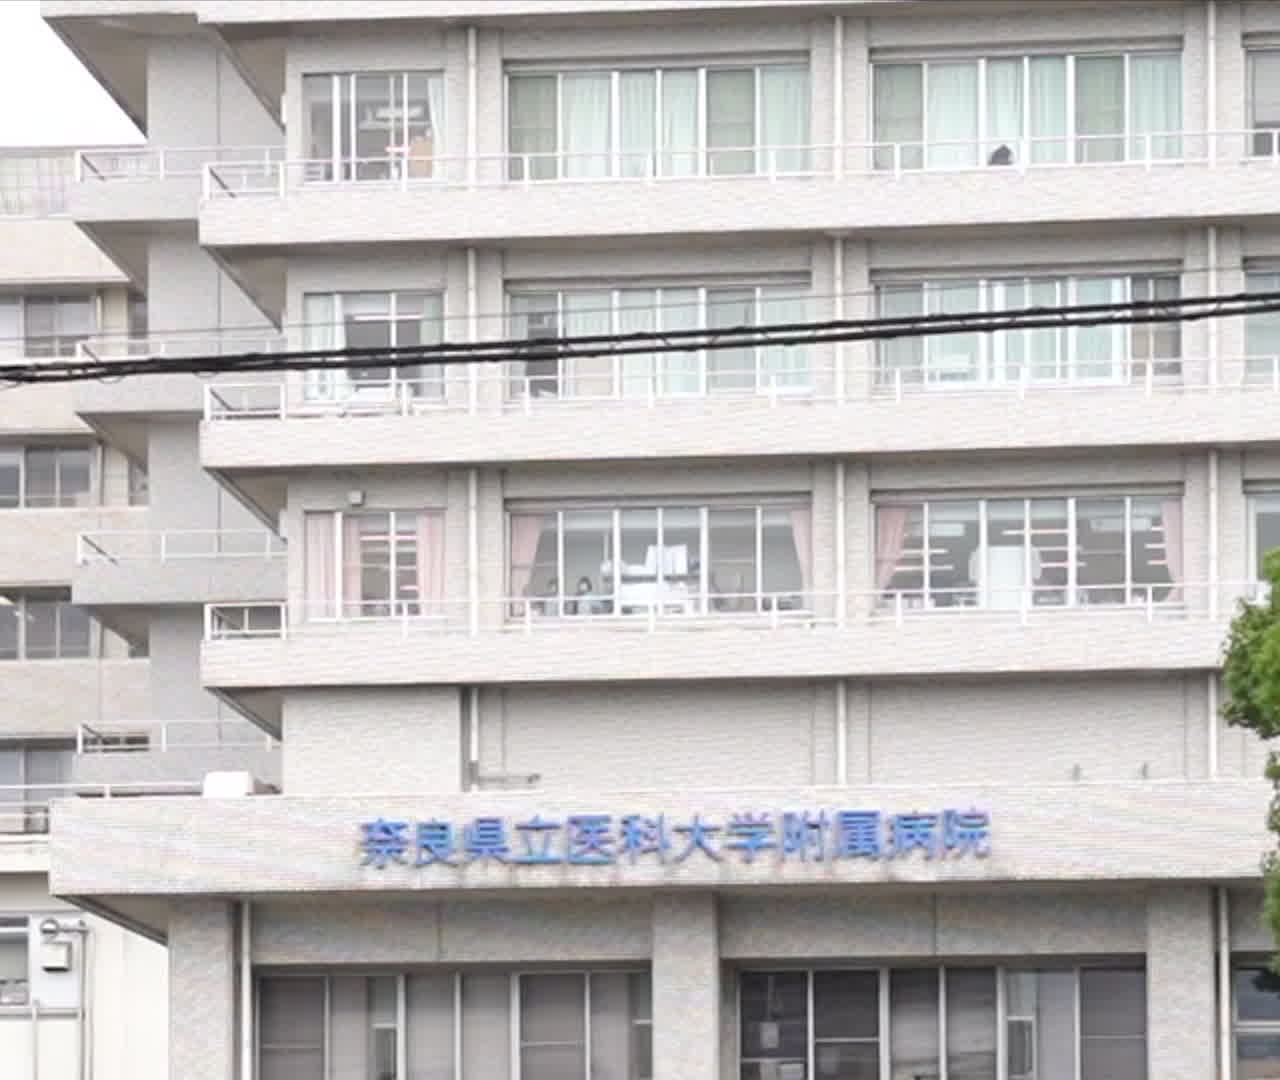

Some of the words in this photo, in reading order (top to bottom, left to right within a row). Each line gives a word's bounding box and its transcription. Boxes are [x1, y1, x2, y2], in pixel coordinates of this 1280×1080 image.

[359, 808, 992, 869] 奈良県立医科大学附属病院
